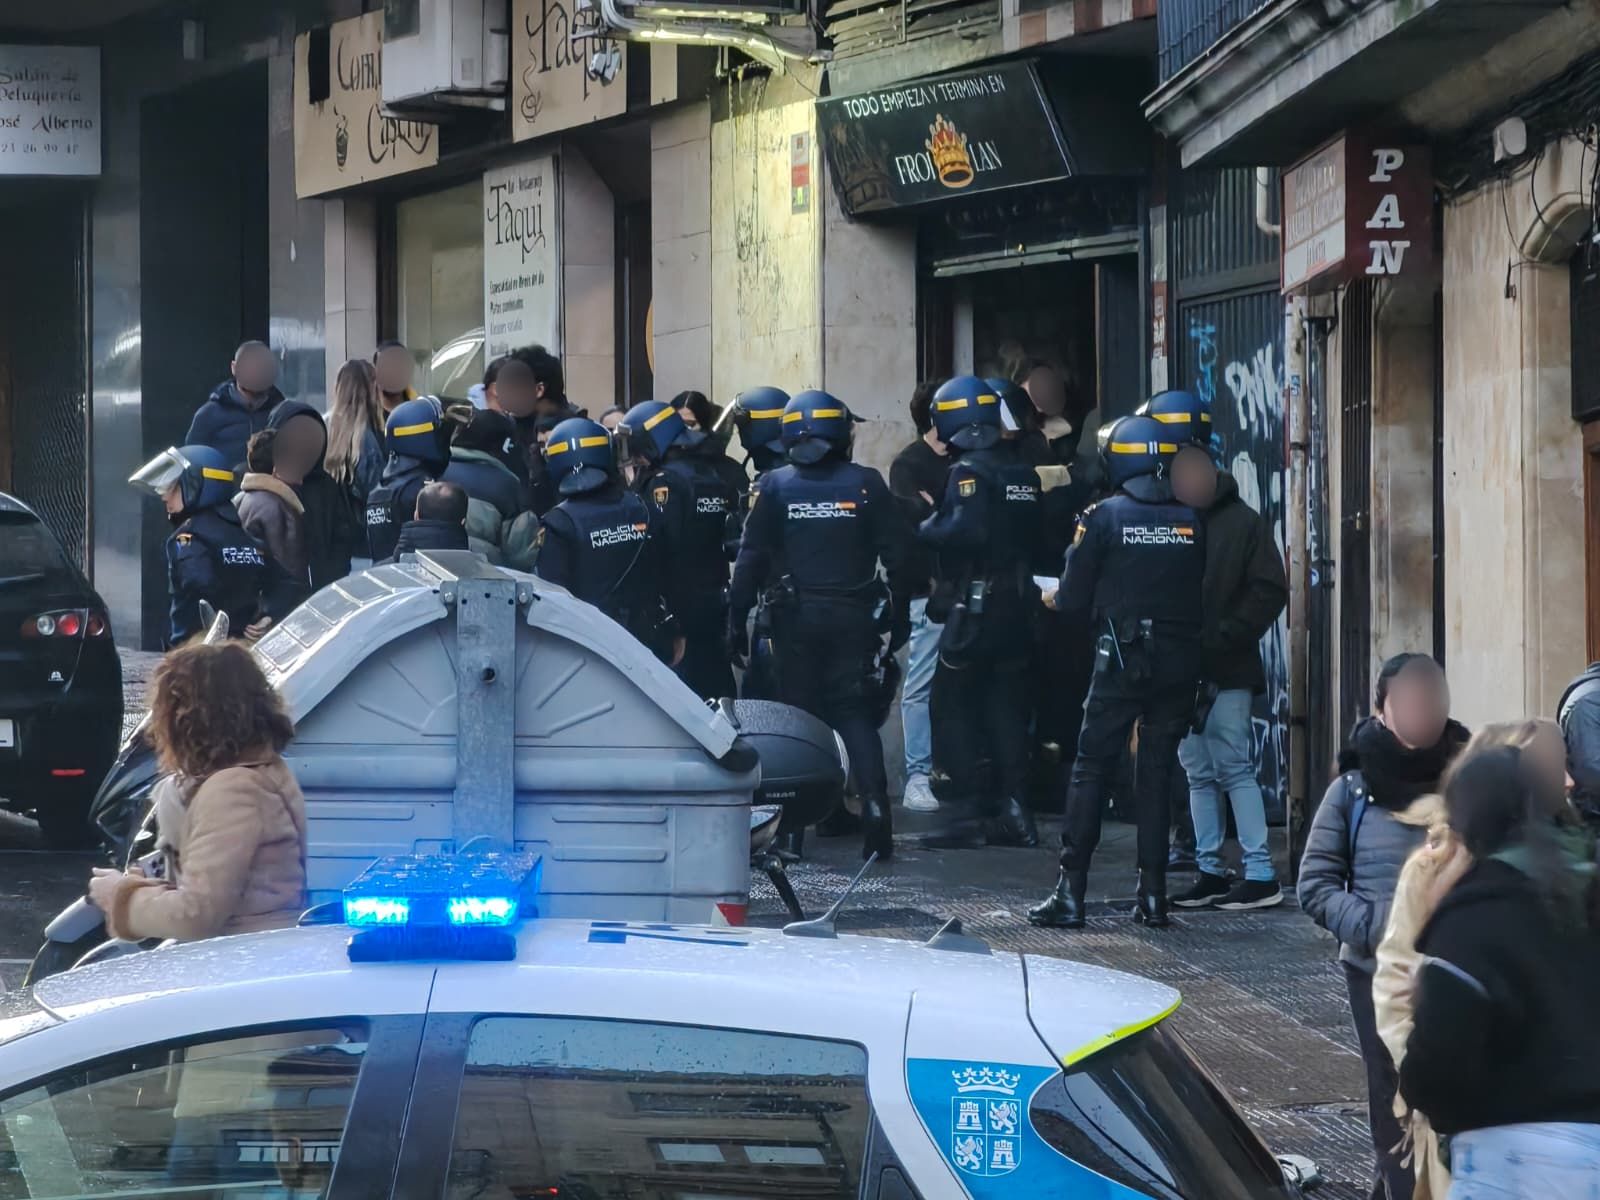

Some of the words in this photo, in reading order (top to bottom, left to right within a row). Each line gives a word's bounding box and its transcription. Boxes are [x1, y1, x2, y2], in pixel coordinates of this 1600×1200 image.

[843, 94, 879, 119] TODO
[880, 86, 931, 113] EMPIEZA
[927, 84, 938, 102] Y
[938, 77, 990, 102] TERMINA
[987, 73, 1006, 94] EN
[32, 114, 94, 133] Alberto
[1365, 148, 1411, 274] PAN
[787, 510, 857, 519] NACIONAL
[1123, 527, 1180, 536] POLICIA
[1123, 535, 1194, 545] NACIONAL
